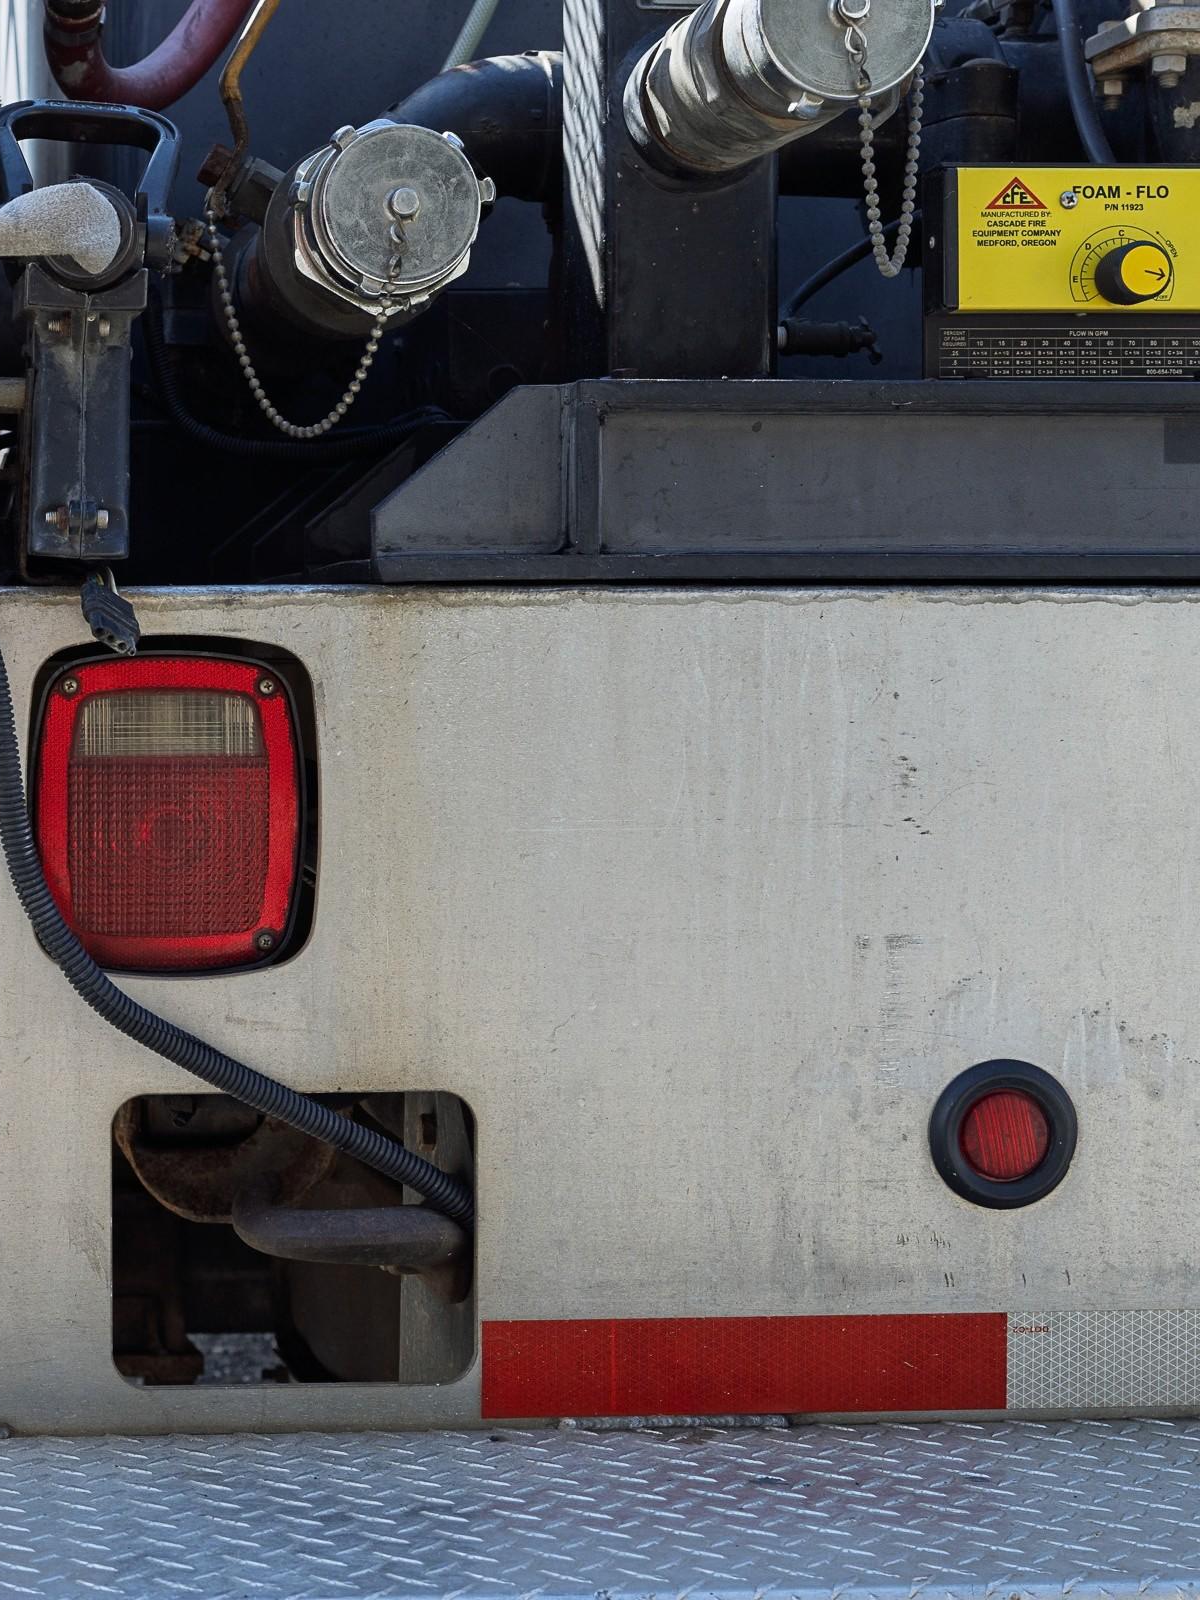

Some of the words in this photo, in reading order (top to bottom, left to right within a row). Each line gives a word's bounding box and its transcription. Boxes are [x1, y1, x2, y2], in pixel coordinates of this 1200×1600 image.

[1072, 186, 1120, 199] FOAM
[1136, 185, 1169, 198] FLO
[1021, 229, 1061, 237] COMPANY
[1165, 240, 1179, 258] OPEN
